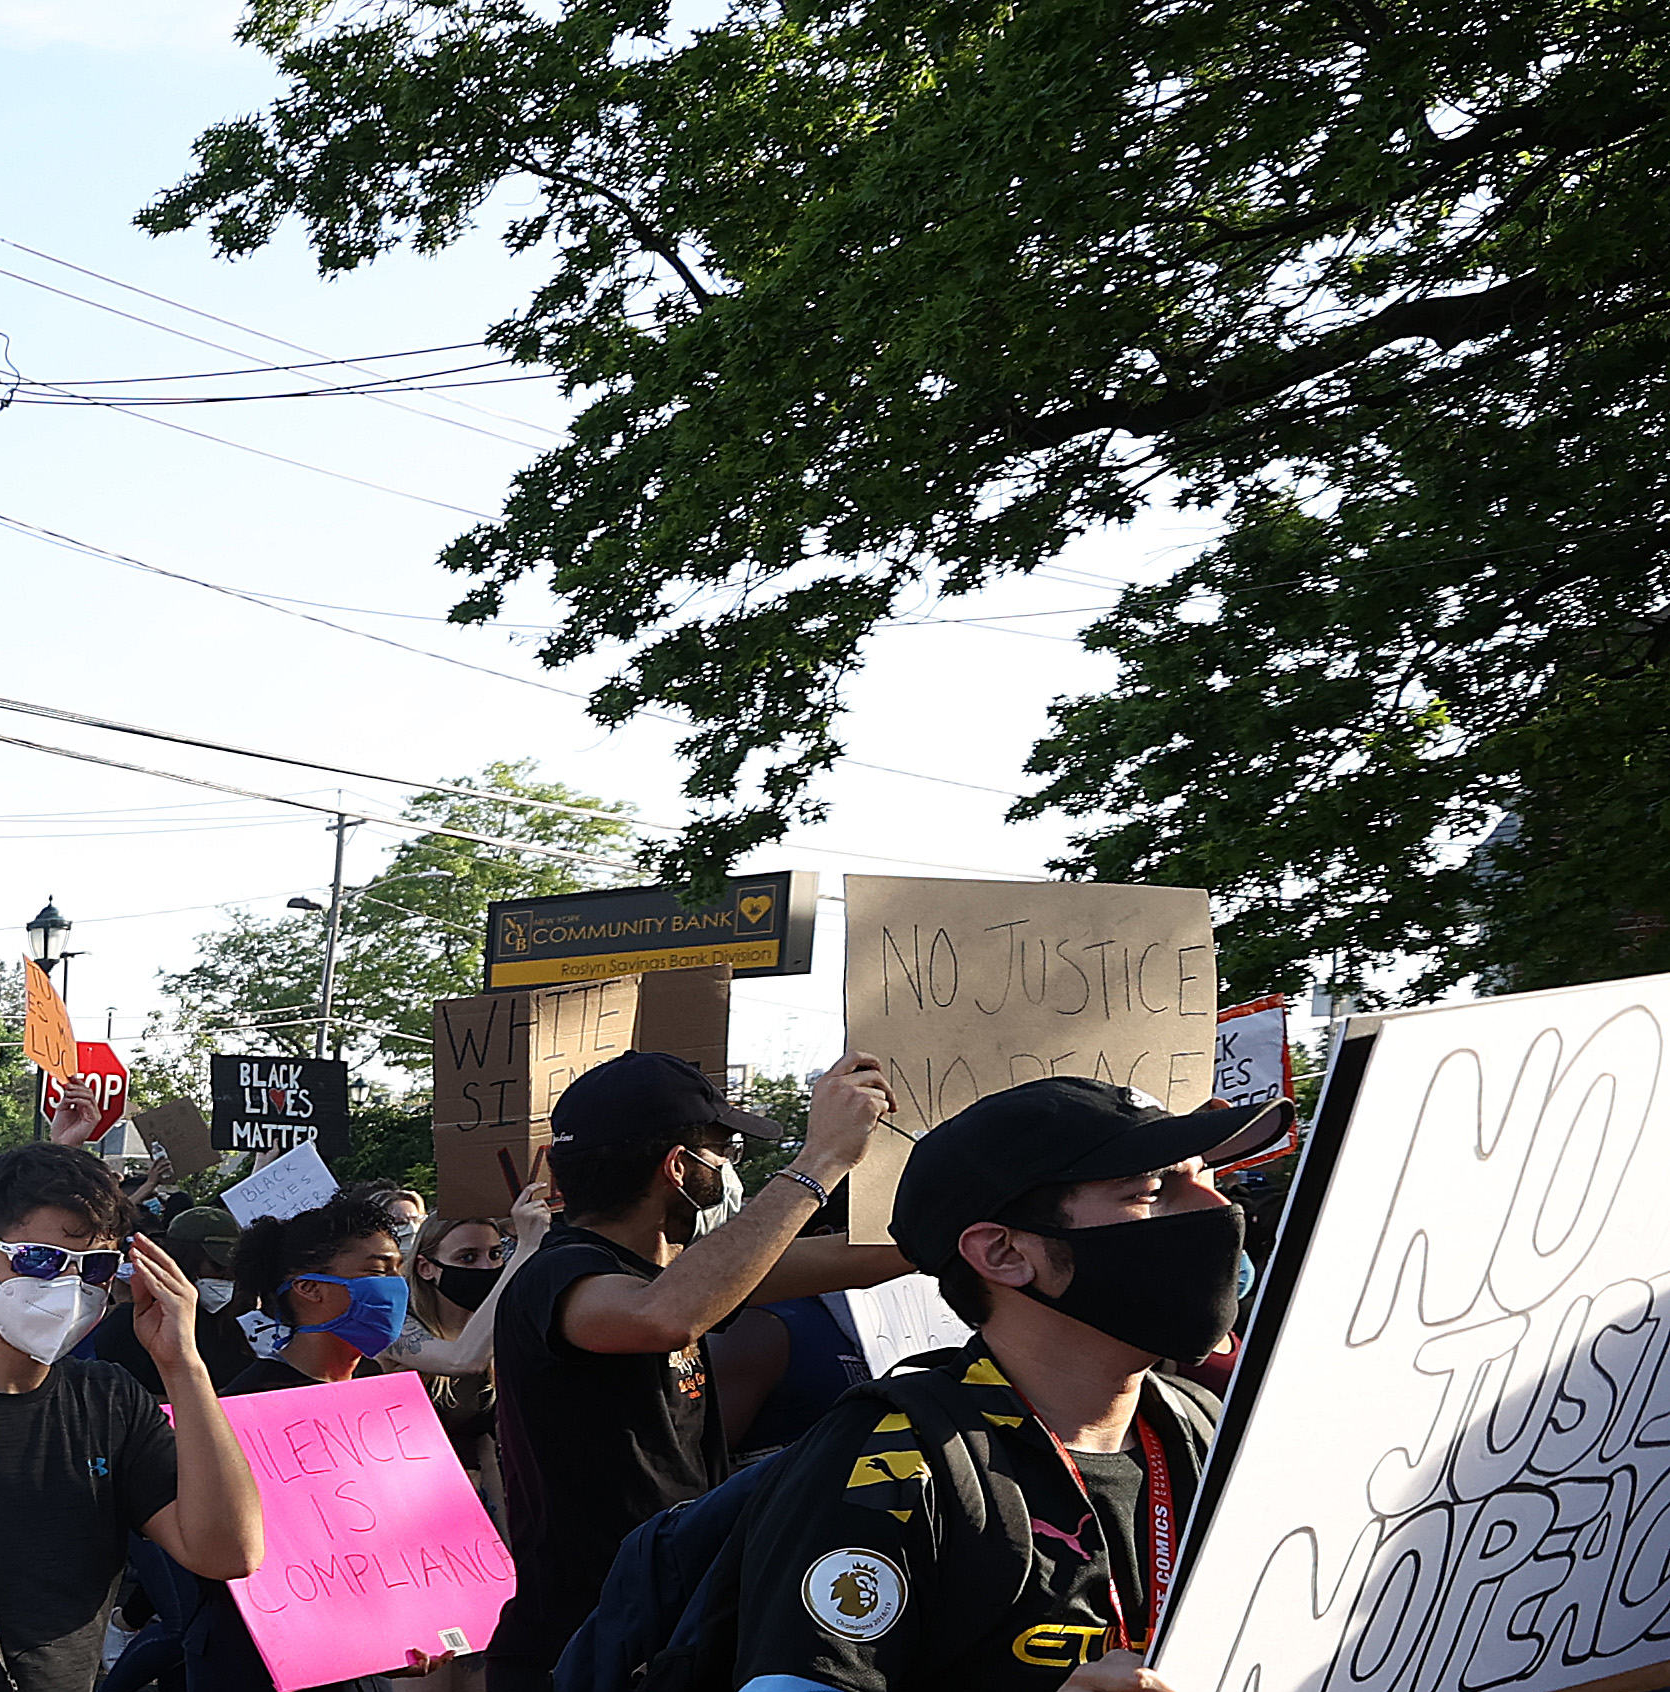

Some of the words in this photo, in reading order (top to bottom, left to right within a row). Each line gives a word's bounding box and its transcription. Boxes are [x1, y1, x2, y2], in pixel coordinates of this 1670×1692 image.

[533, 916, 668, 944] COMMUNITY
[671, 910, 734, 931] BANK
[561, 959, 606, 977] Roslyn
[670, 953, 708, 968] Bank
[712, 947, 772, 965] Division
[883, 923, 958, 1016] NO
[975, 919, 1208, 1020] JUSTICE
[443, 979, 621, 1071] WHITE
[239, 1062, 303, 1090] BLACK
[232, 1121, 319, 1151] MATTER
[240, 1161, 298, 1204] BLACK
[1346, 1004, 1664, 1348] NO
[243, 1404, 431, 1484] ILENCE
[310, 1480, 377, 1541] IS
[1154, 1504, 1172, 1583] COMICS
[246, 1538, 517, 1614] COMPLIANCE
